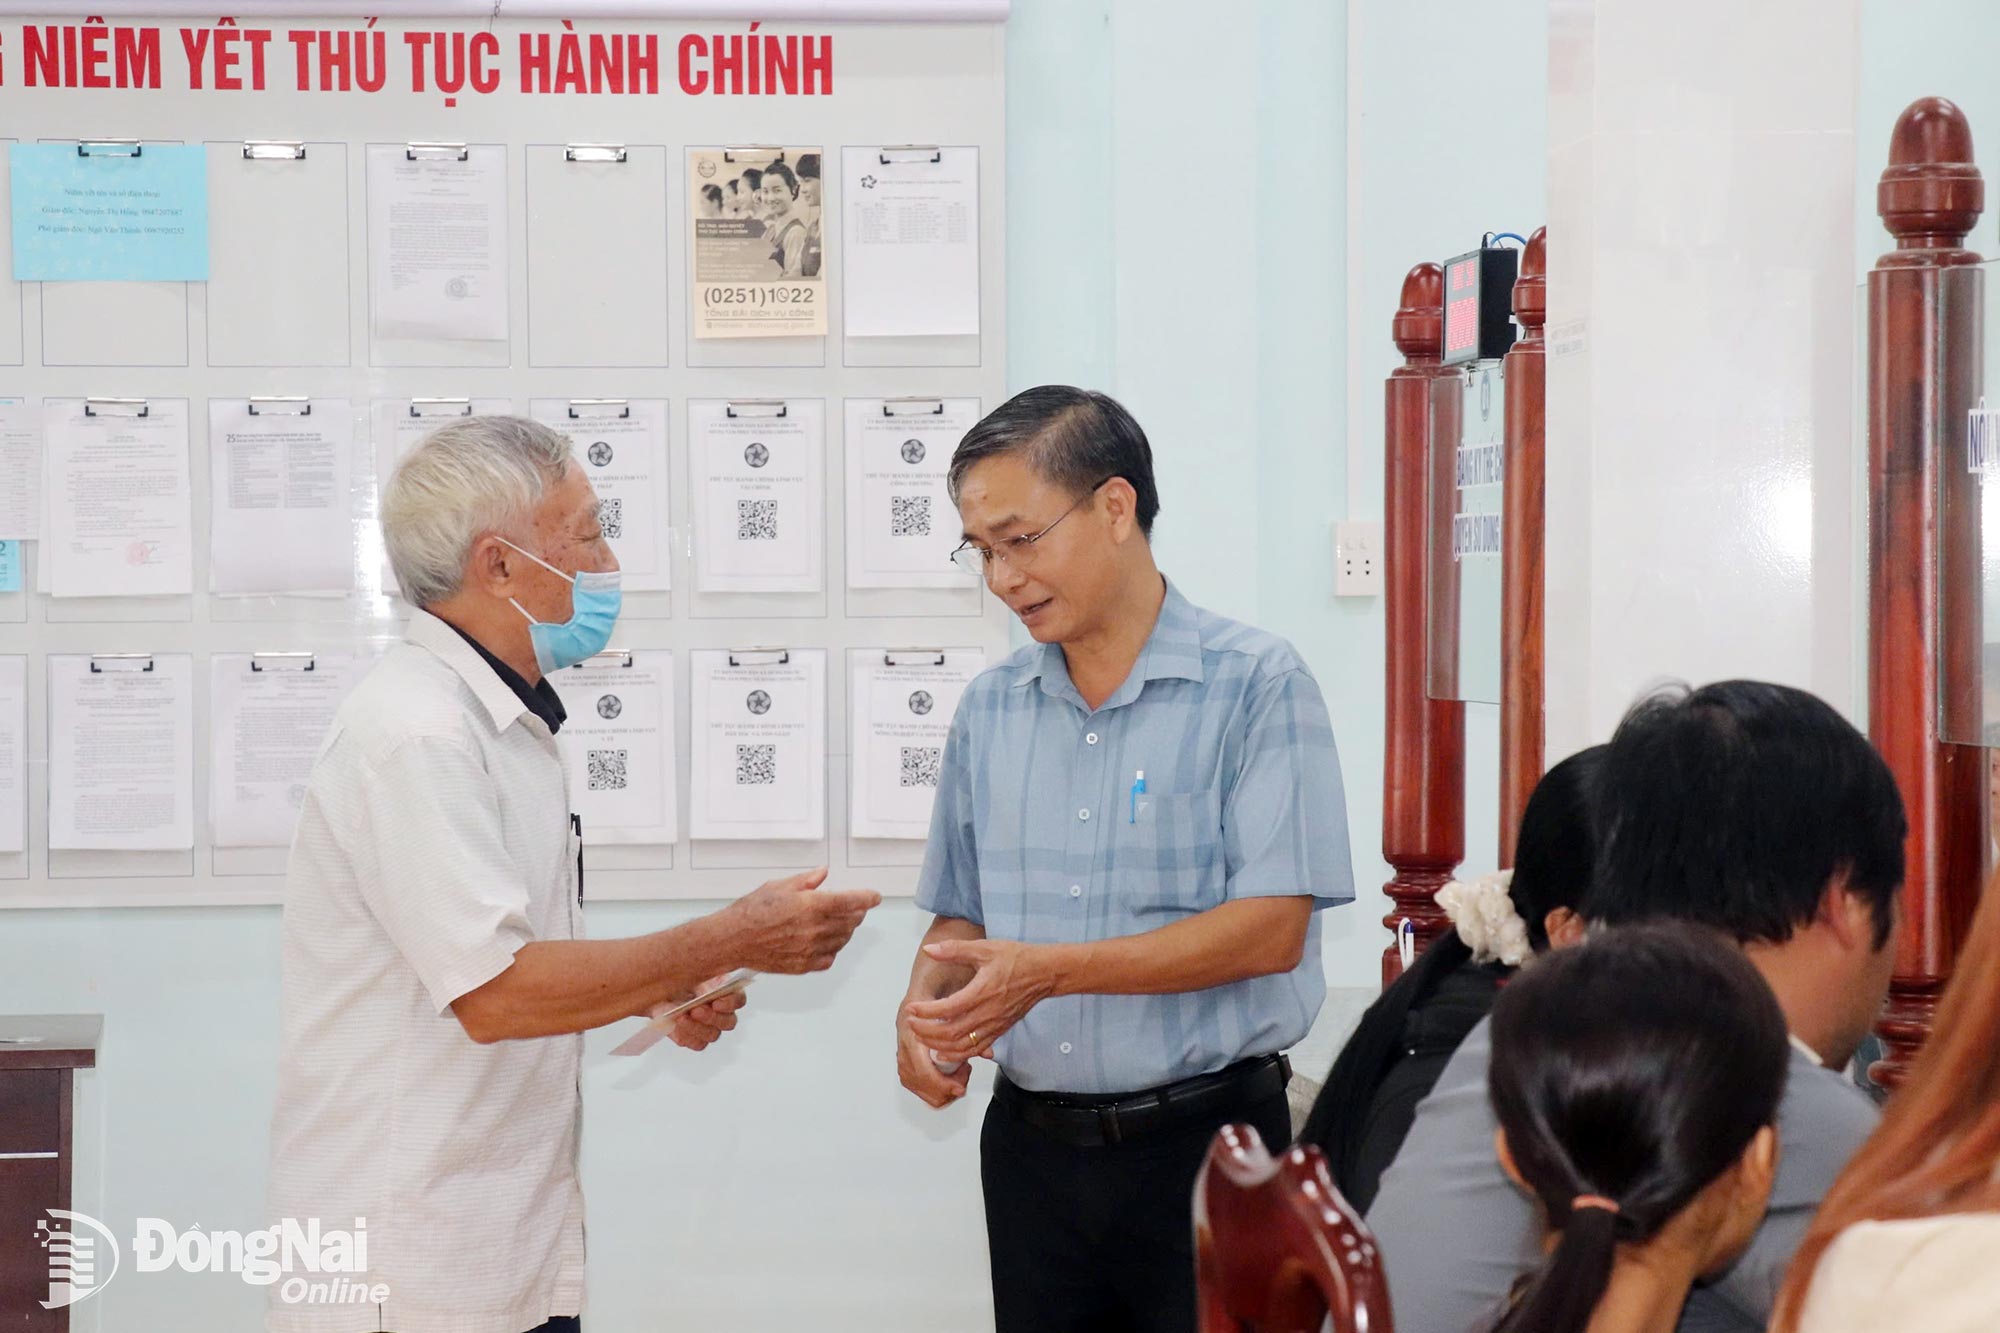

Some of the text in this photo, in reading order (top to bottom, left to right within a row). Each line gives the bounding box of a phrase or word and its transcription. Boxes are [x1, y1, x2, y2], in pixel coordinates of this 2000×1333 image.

[23, 16, 161, 89] NIÊM
[404, 32, 500, 108] TỤC
[519, 20, 659, 95] HÀNH
[678, 22, 833, 96] CHÍNH
